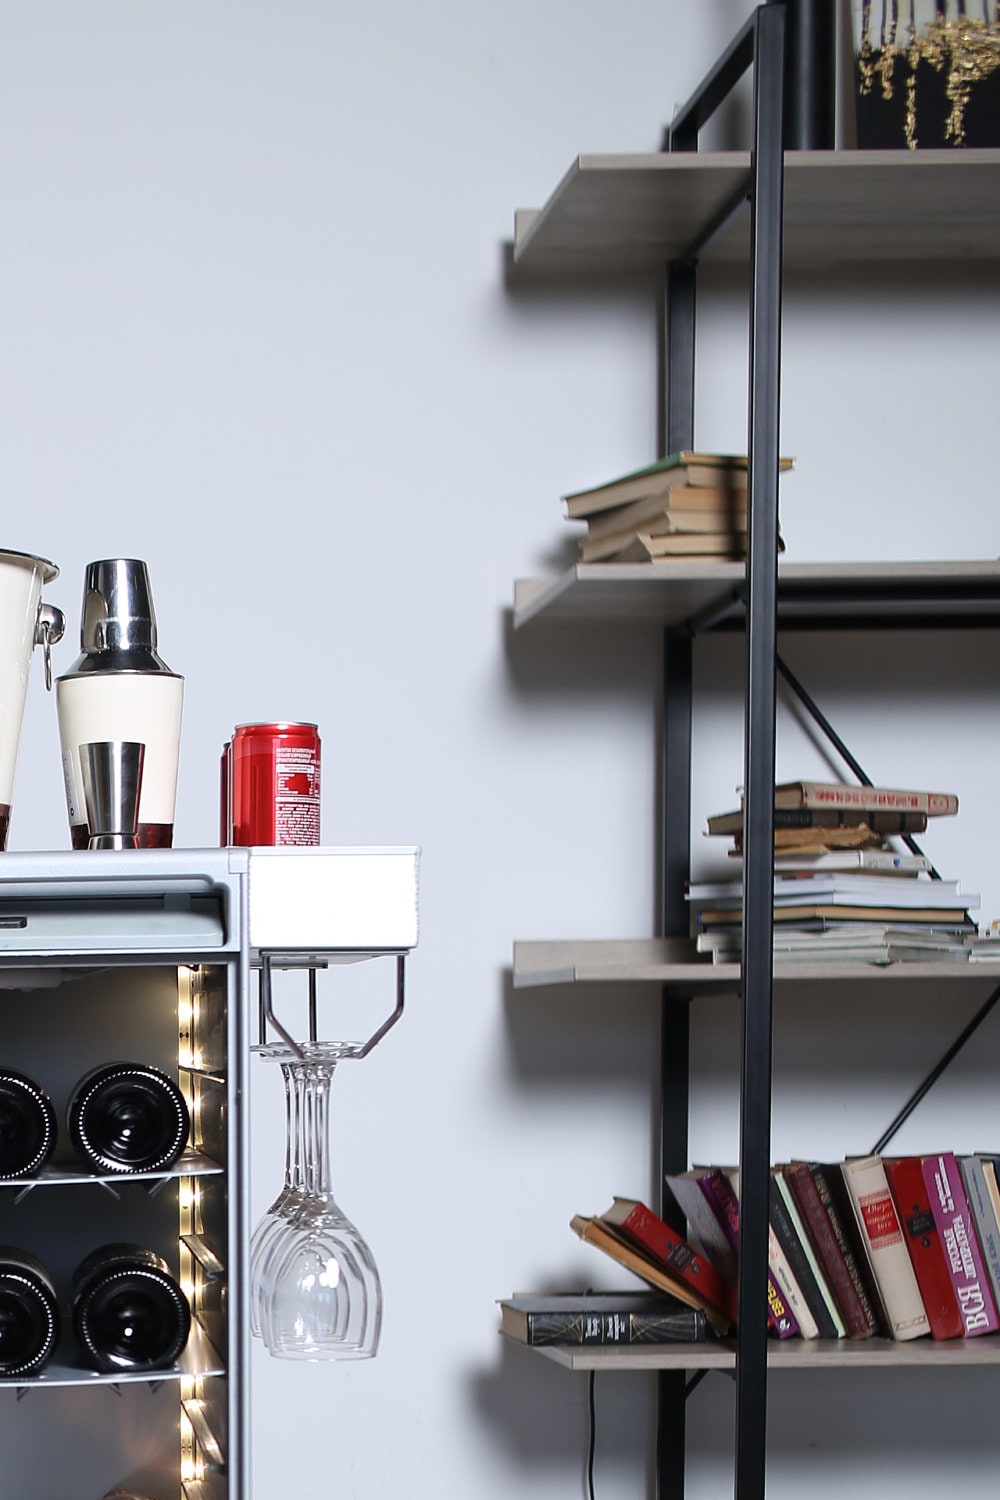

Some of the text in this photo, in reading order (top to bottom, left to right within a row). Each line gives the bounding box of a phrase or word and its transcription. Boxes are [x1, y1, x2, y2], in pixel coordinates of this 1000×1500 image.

[943, 1227, 963, 1274] РУССКАЯ
[952, 1214, 977, 1279] ЛИТЕРАТУРА
[958, 1281, 990, 1332] ВСЯ
